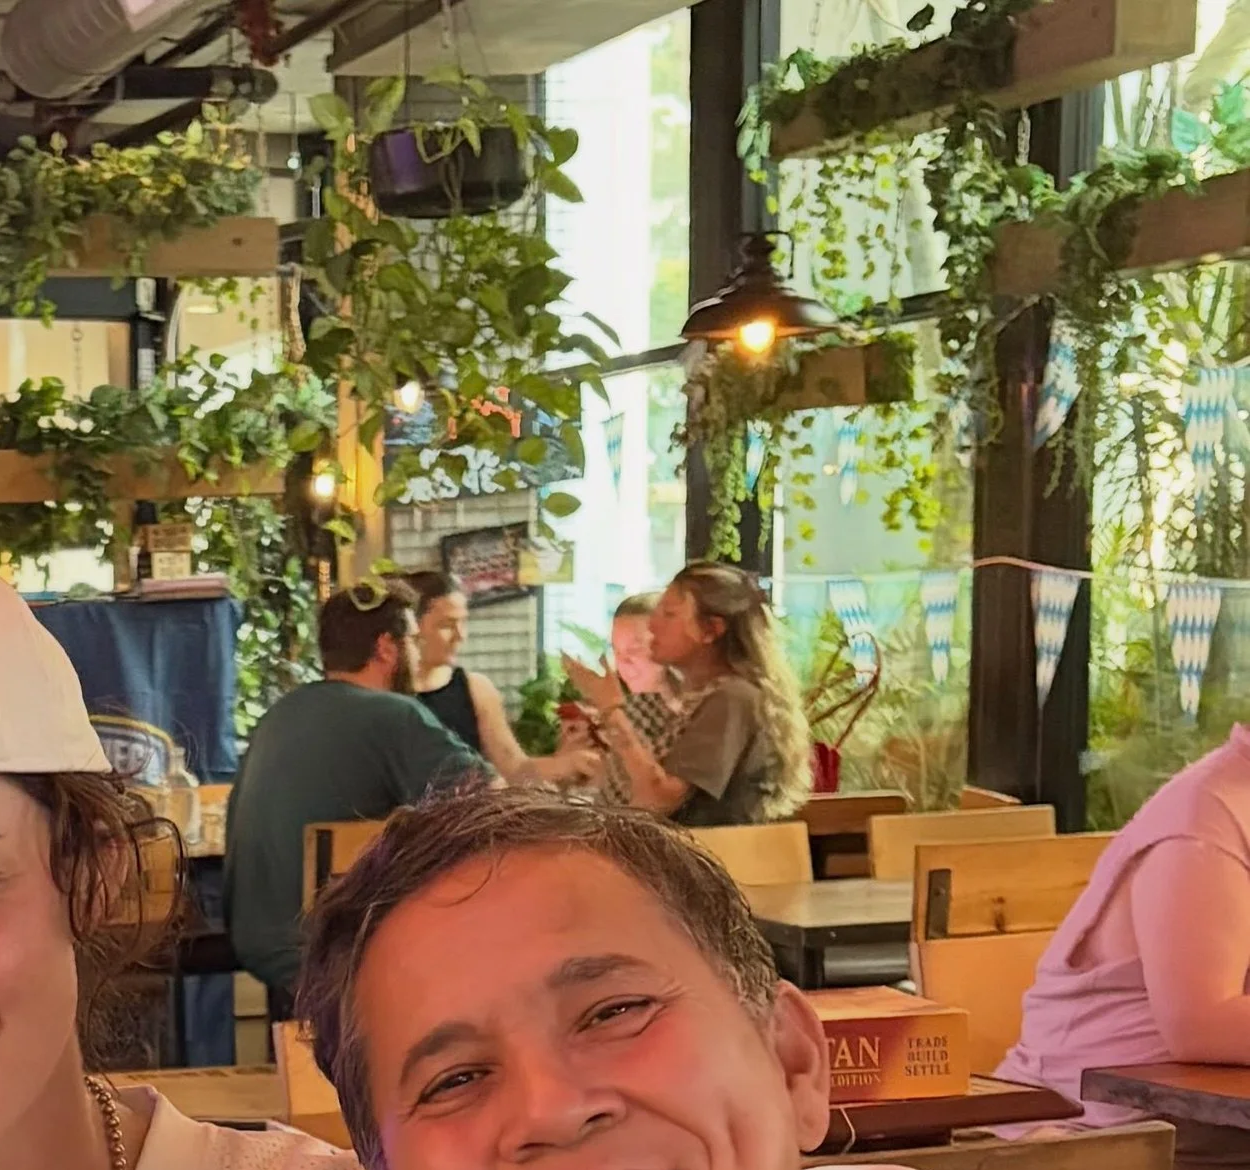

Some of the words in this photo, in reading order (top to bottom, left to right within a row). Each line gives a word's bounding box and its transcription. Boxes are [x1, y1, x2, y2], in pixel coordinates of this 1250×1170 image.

[907, 1036, 949, 1049] TRADE
[907, 1050, 949, 1061] BUILD
[905, 1064, 950, 1077] SETTLE
